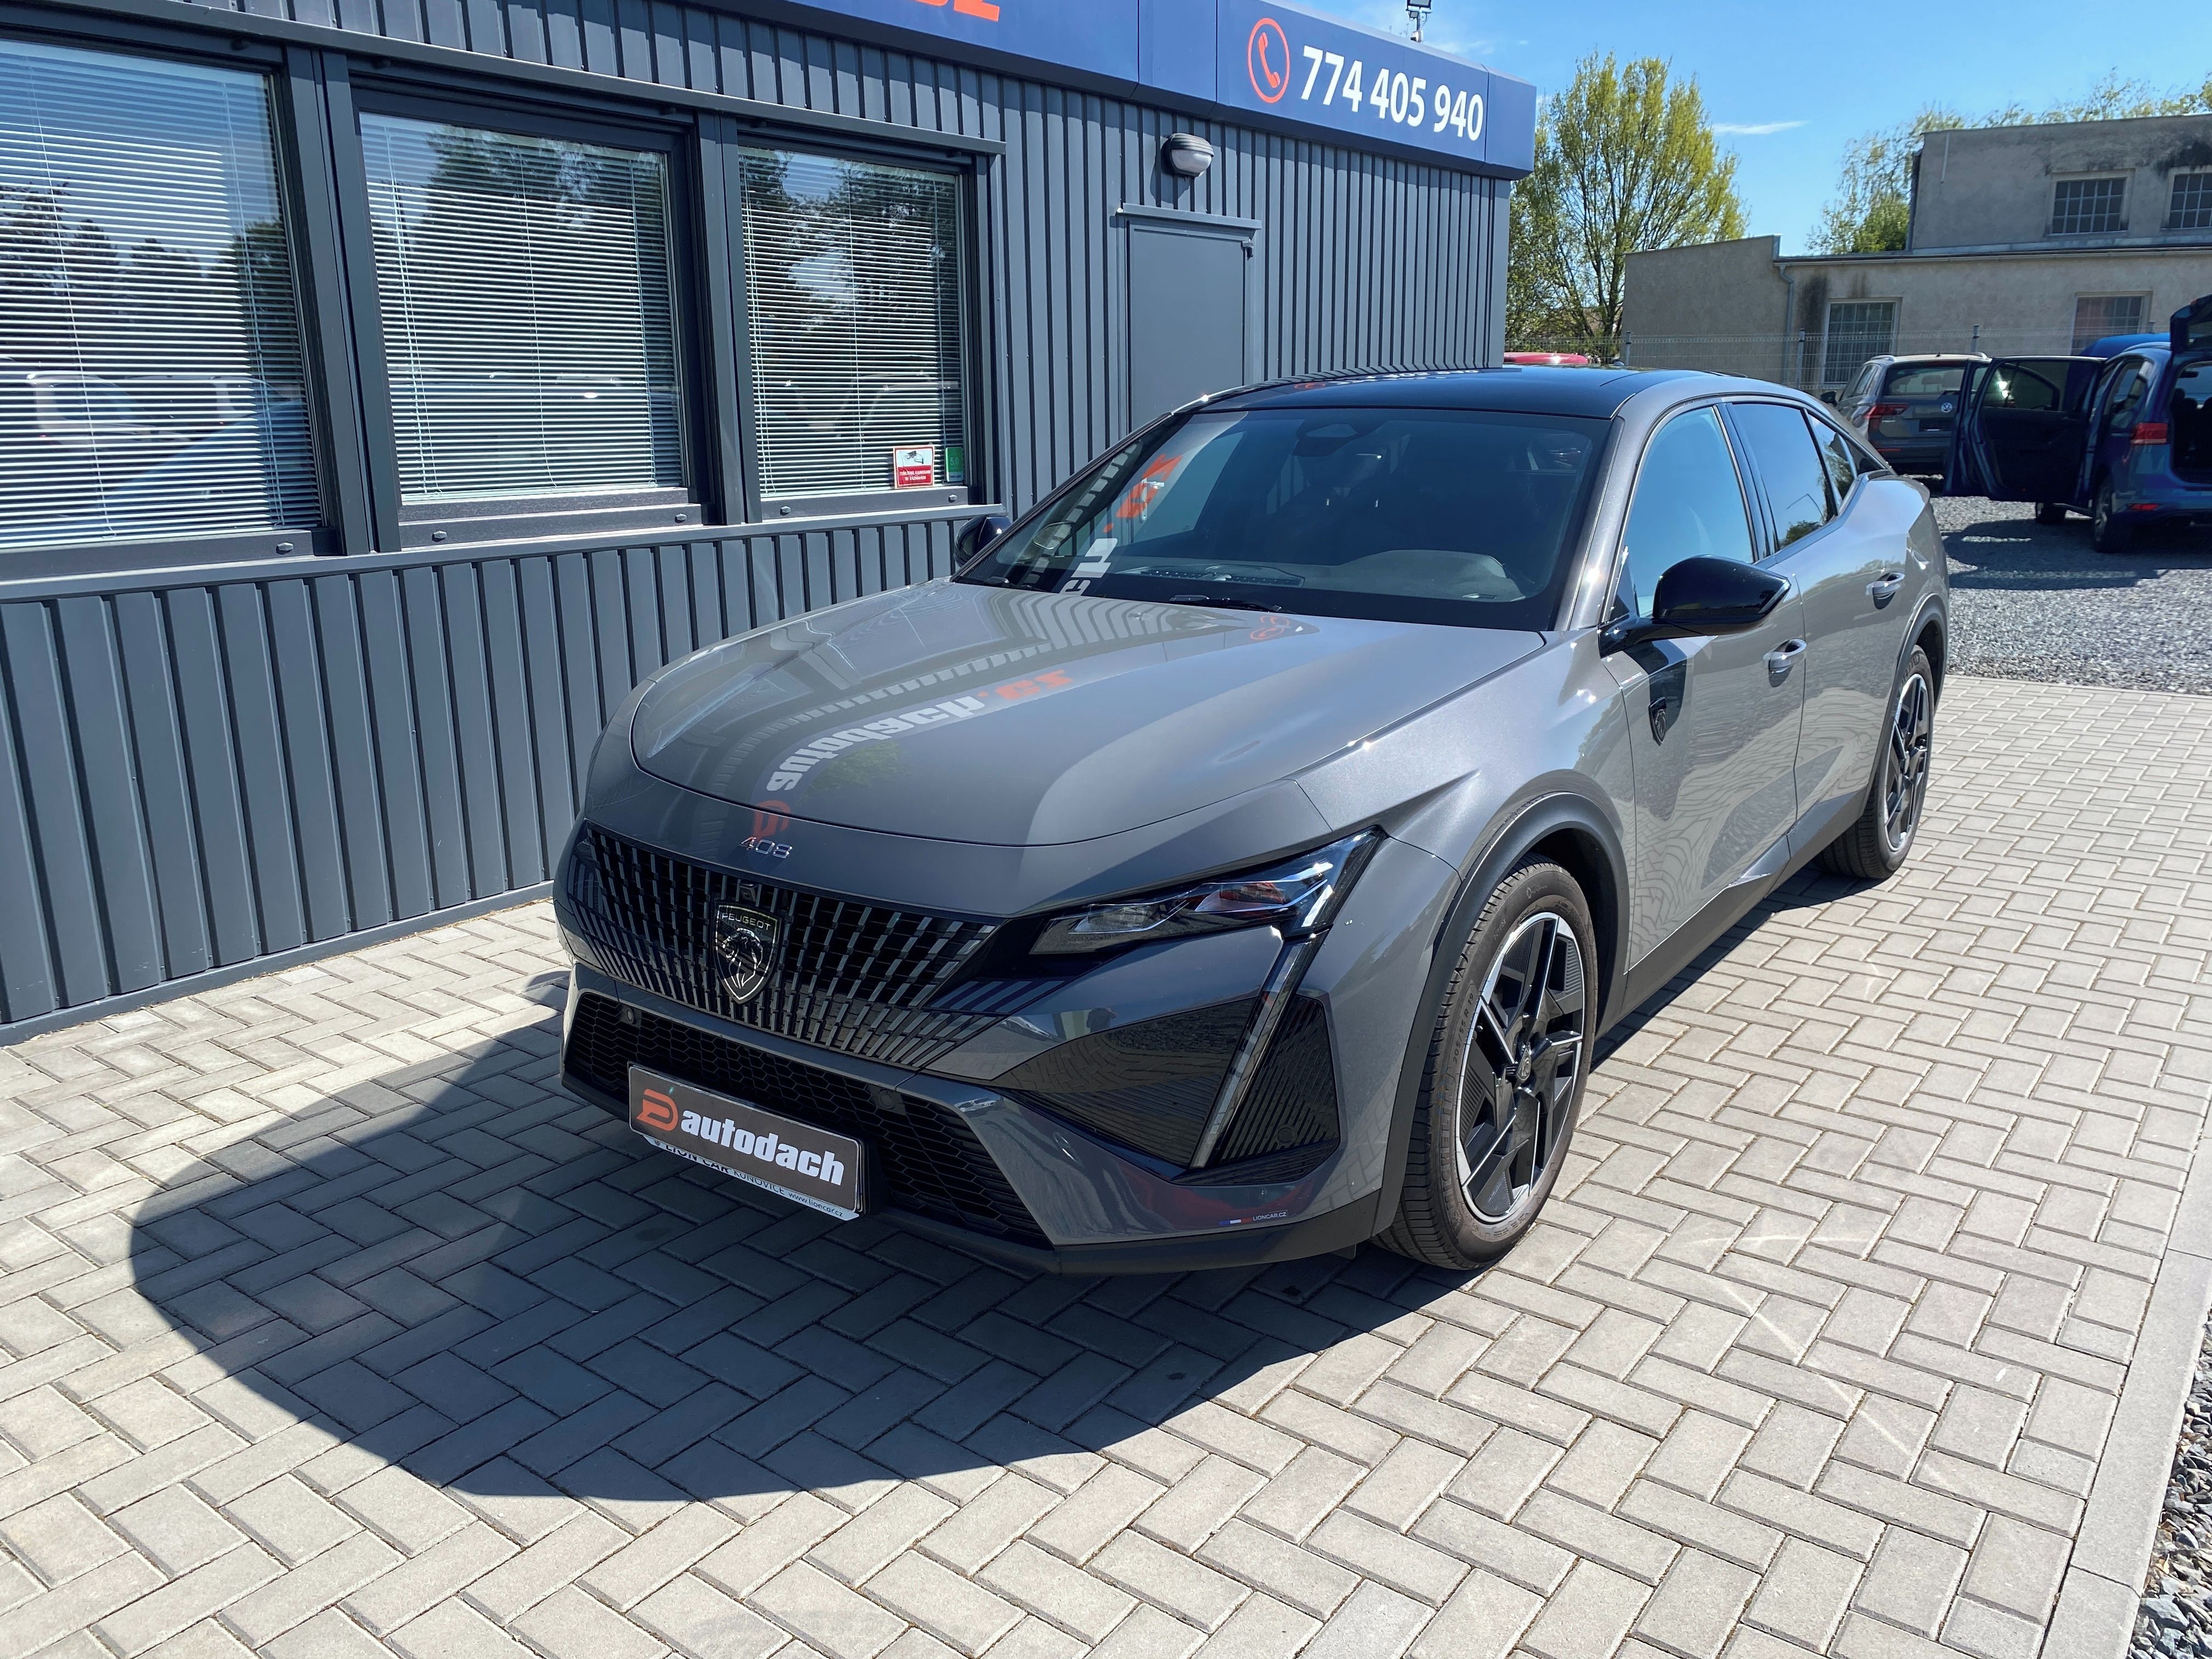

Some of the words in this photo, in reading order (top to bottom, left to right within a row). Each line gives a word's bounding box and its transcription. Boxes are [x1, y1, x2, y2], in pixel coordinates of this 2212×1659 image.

[1301, 45, 1363, 113] 774
[1370, 68, 1426, 127] 405
[1434, 84, 1484, 141] 940
[739, 836, 793, 859] 408
[721, 912, 771, 931] PEUGEOT
[1453, 1019, 1466, 1063] 205/55
[1464, 1008, 1470, 1018] R
[1468, 993, 1474, 1005] 19
[680, 1109, 844, 1186] autodach
[1441, 1081, 1454, 1211] MICHELIN
[788, 1193, 843, 1217] www.lioncar.cz
[1252, 1211, 1286, 1221] LIONCAR.CZ
